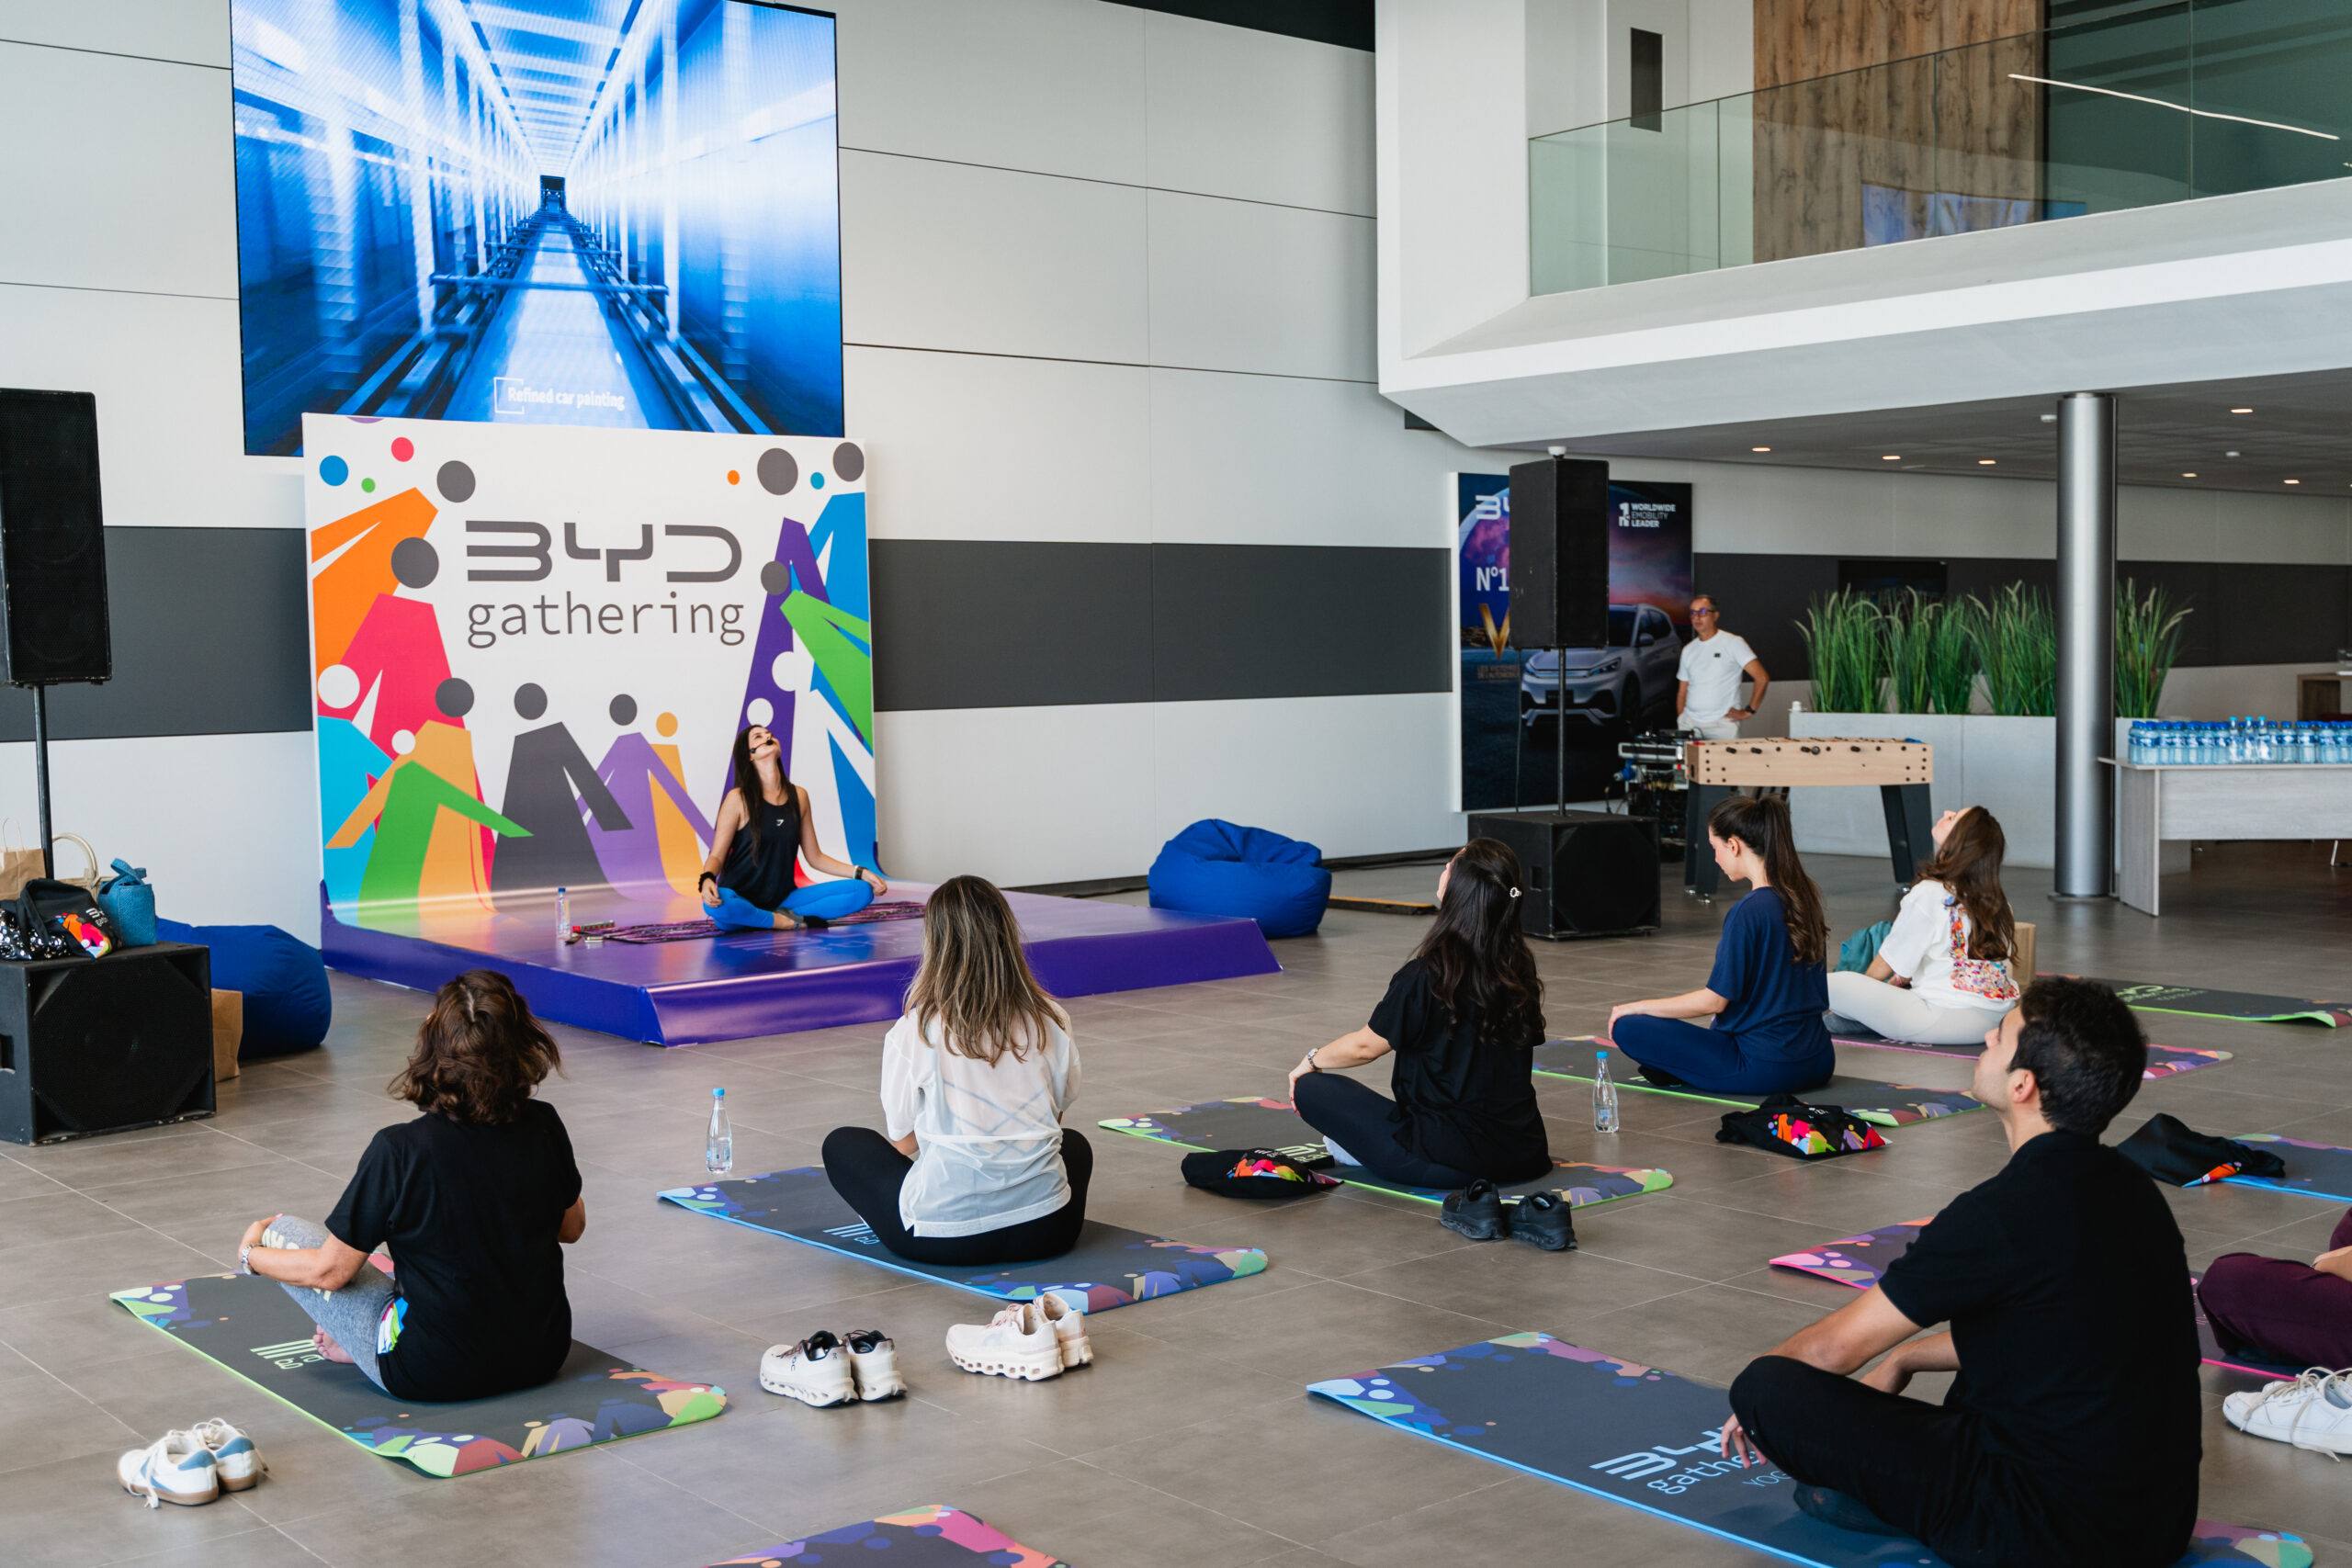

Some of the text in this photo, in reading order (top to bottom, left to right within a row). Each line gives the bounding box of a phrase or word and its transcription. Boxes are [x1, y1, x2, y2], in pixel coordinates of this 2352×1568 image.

[507, 387, 626, 411] Refined car painting
[1631, 502, 1676, 512] WORLDWIDE
[1631, 511, 1668, 520] EMOBILITY
[1632, 519, 1660, 527] LEADER
[466, 520, 742, 582] BYD
[467, 591, 746, 649] gathering
[1589, 1427, 1725, 1481] BY
[1742, 1470, 1792, 1487] YOG
